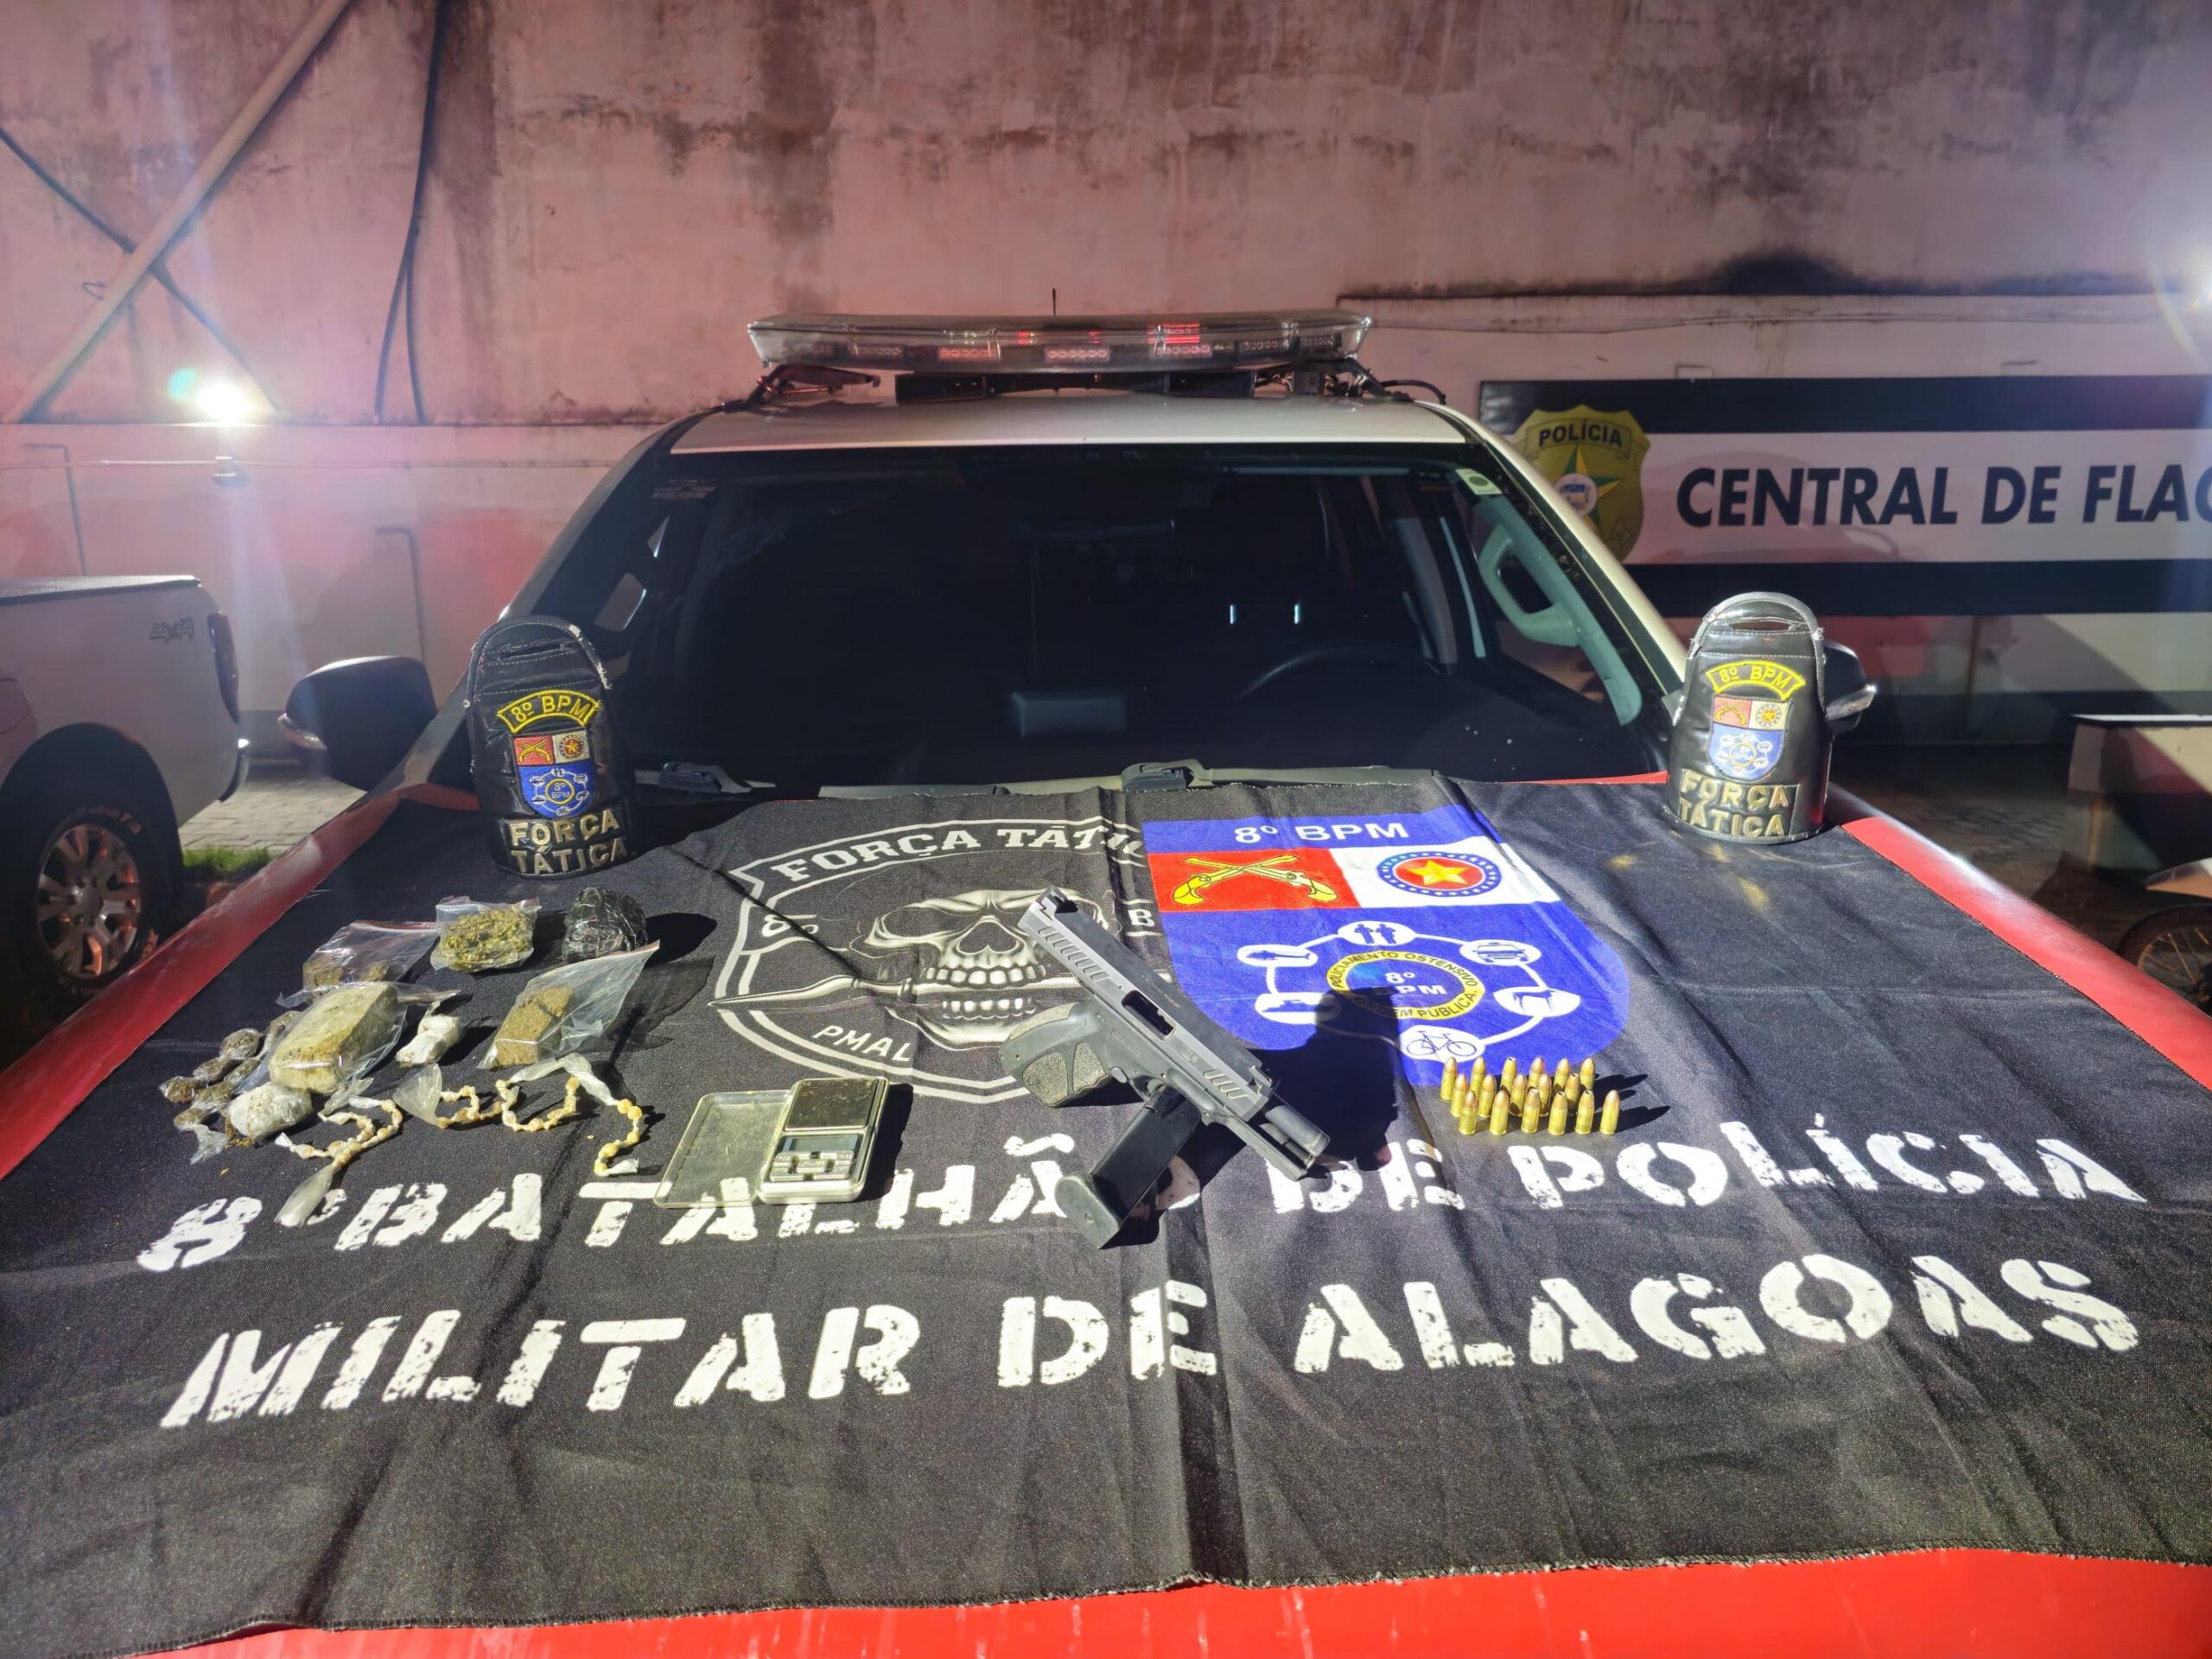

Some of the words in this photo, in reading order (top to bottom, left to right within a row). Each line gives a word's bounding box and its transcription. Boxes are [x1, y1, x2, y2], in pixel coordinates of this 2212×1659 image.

[1539, 418, 1622, 448] POLÍCIA
[1676, 465, 1958, 528] CENTRAL
[1981, 465, 2062, 524] DE
[1750, 665, 1790, 690] BPM
[542, 696, 588, 719] BPM
[1681, 769, 1790, 810] FORÇA
[509, 809, 620, 846] FORÇA
[1295, 822, 1410, 842] BPM
[1679, 797, 1786, 837] TÁTICA
[511, 837, 628, 875] TÁTICA
[769, 827, 980, 882] FORÇA
[1331, 951, 1399, 988] POLICIAMENTO
[1404, 953, 1478, 987] OSTENSIVO
[812, 1025, 912, 1061] PMAL
[1264, 1138, 1465, 1212] DE
[1507, 1113, 2147, 1209] POLÍCIA
[159, 1306, 921, 1429] MILITAR
[997, 1280, 1217, 1389] DE
[1294, 1254, 2139, 1374] ALAGOAS
